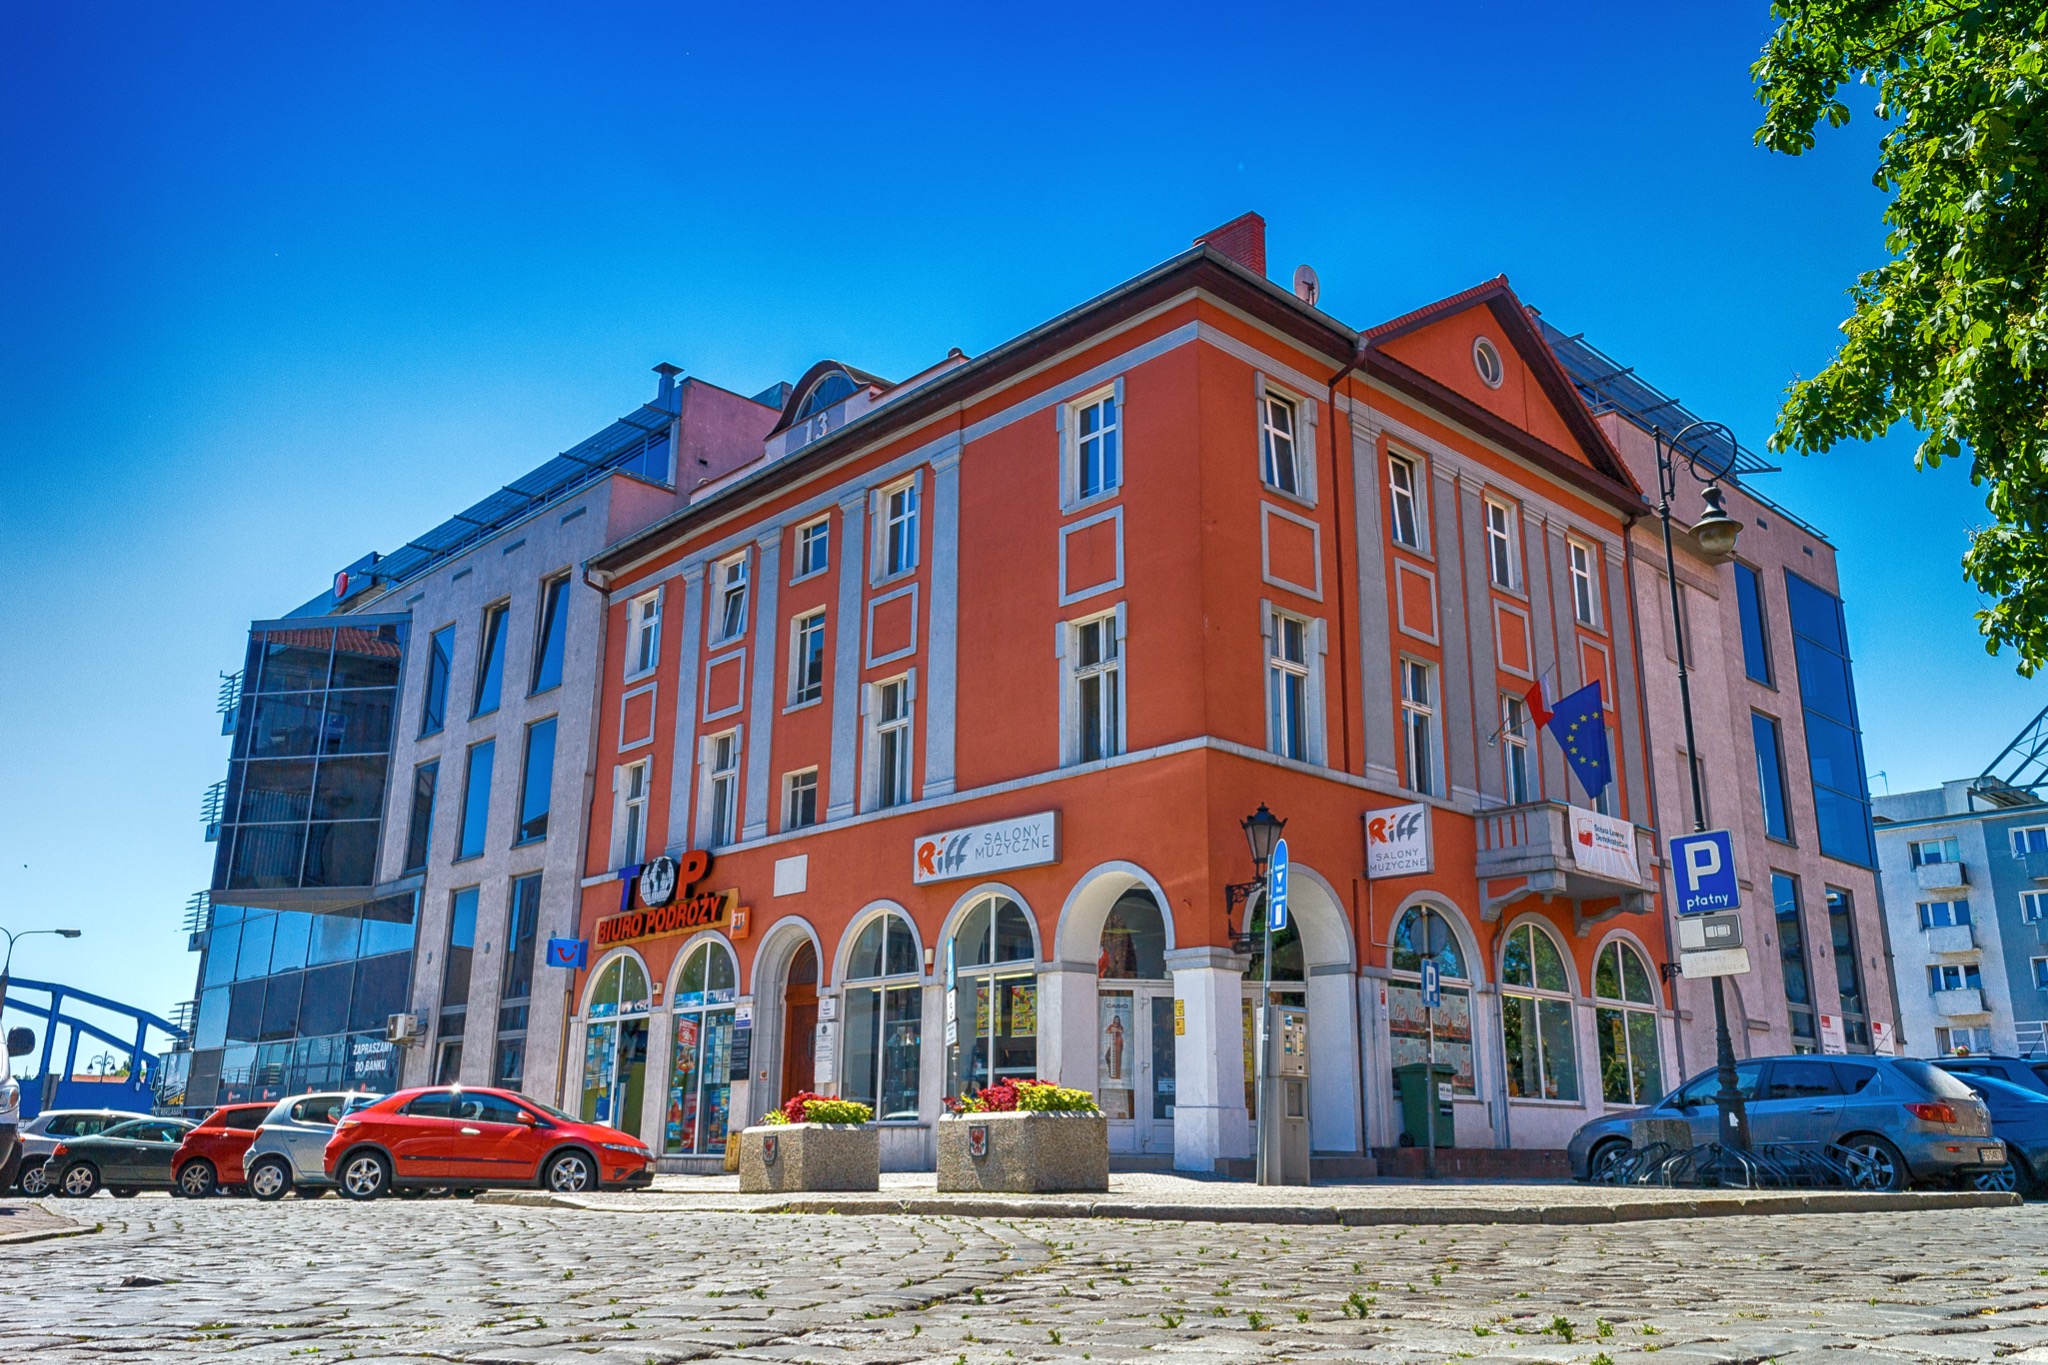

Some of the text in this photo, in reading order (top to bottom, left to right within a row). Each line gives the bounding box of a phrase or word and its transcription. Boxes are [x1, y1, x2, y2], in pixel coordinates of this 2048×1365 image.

[804, 412, 829, 445] 13
[984, 824, 1041, 846] SALONY
[1368, 812, 1424, 847] Riff
[917, 833, 973, 880] Riff
[975, 835, 1050, 859] MUZYCZNE
[1376, 848, 1418, 861] SALONY
[1369, 858, 1426, 872] MUZYCZNE
[1684, 840, 1722, 891] P
[1686, 893, 1729, 910] płatny
[597, 892, 722, 944] BIURO PODRÓŻY
[1426, 965, 1436, 1001] P
[353, 1041, 394, 1055] ZAPRASZAMY
[355, 1060, 387, 1072] DO BANKU
